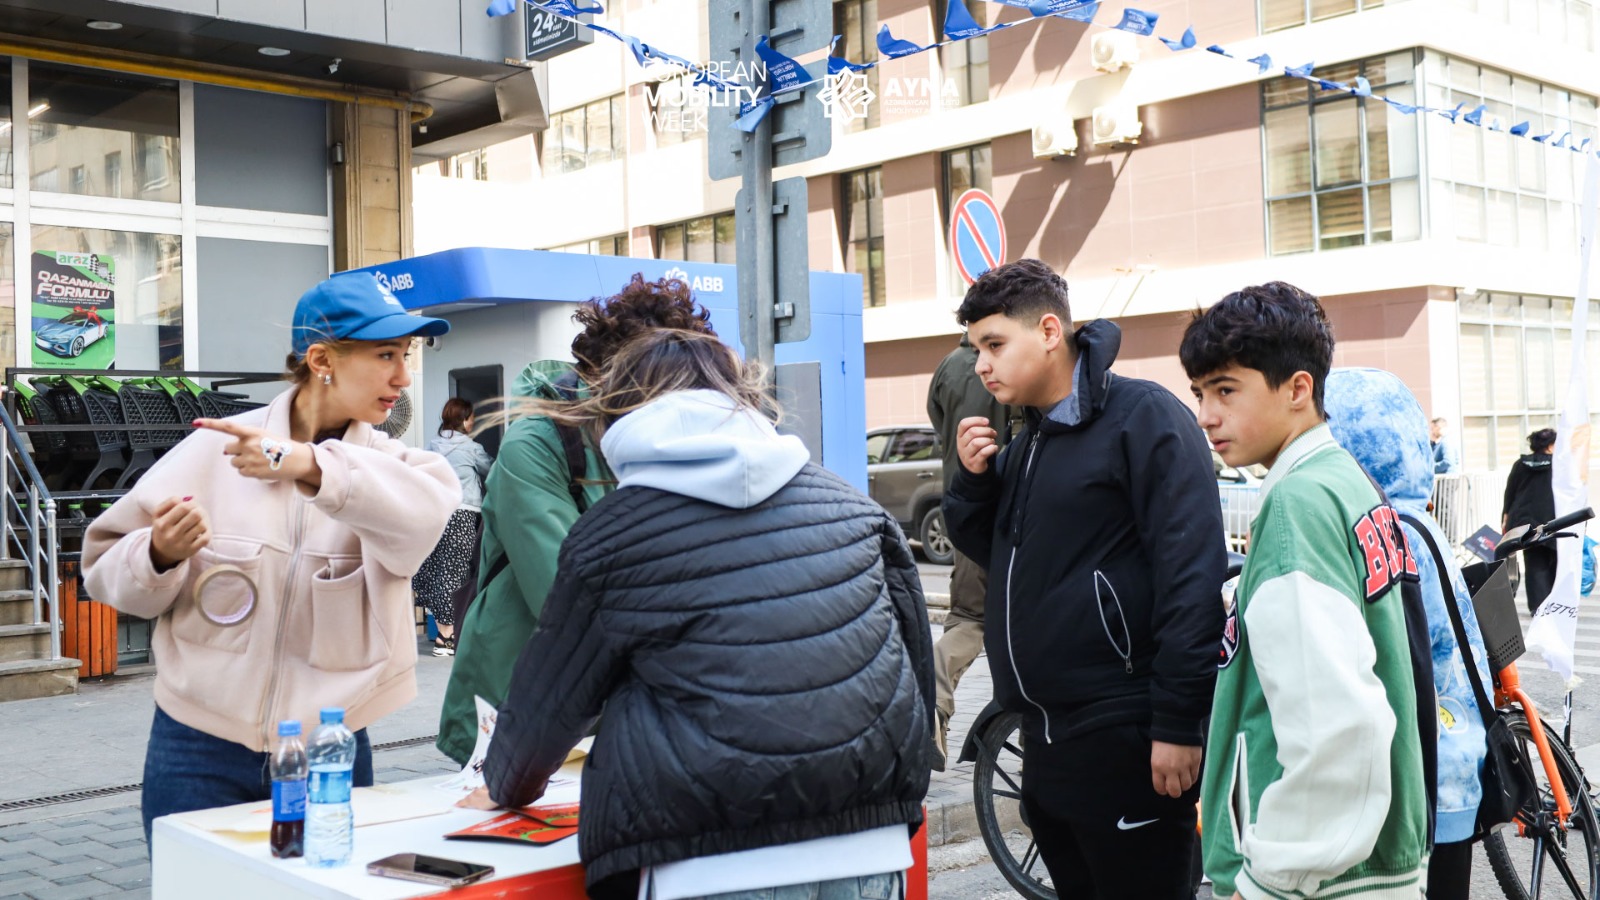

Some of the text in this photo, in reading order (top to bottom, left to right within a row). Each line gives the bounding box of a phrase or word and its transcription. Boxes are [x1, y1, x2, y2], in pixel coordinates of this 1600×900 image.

[58, 254, 89, 265] araz
[391, 273, 415, 292] ABB
[692, 275, 724, 293] ABB
